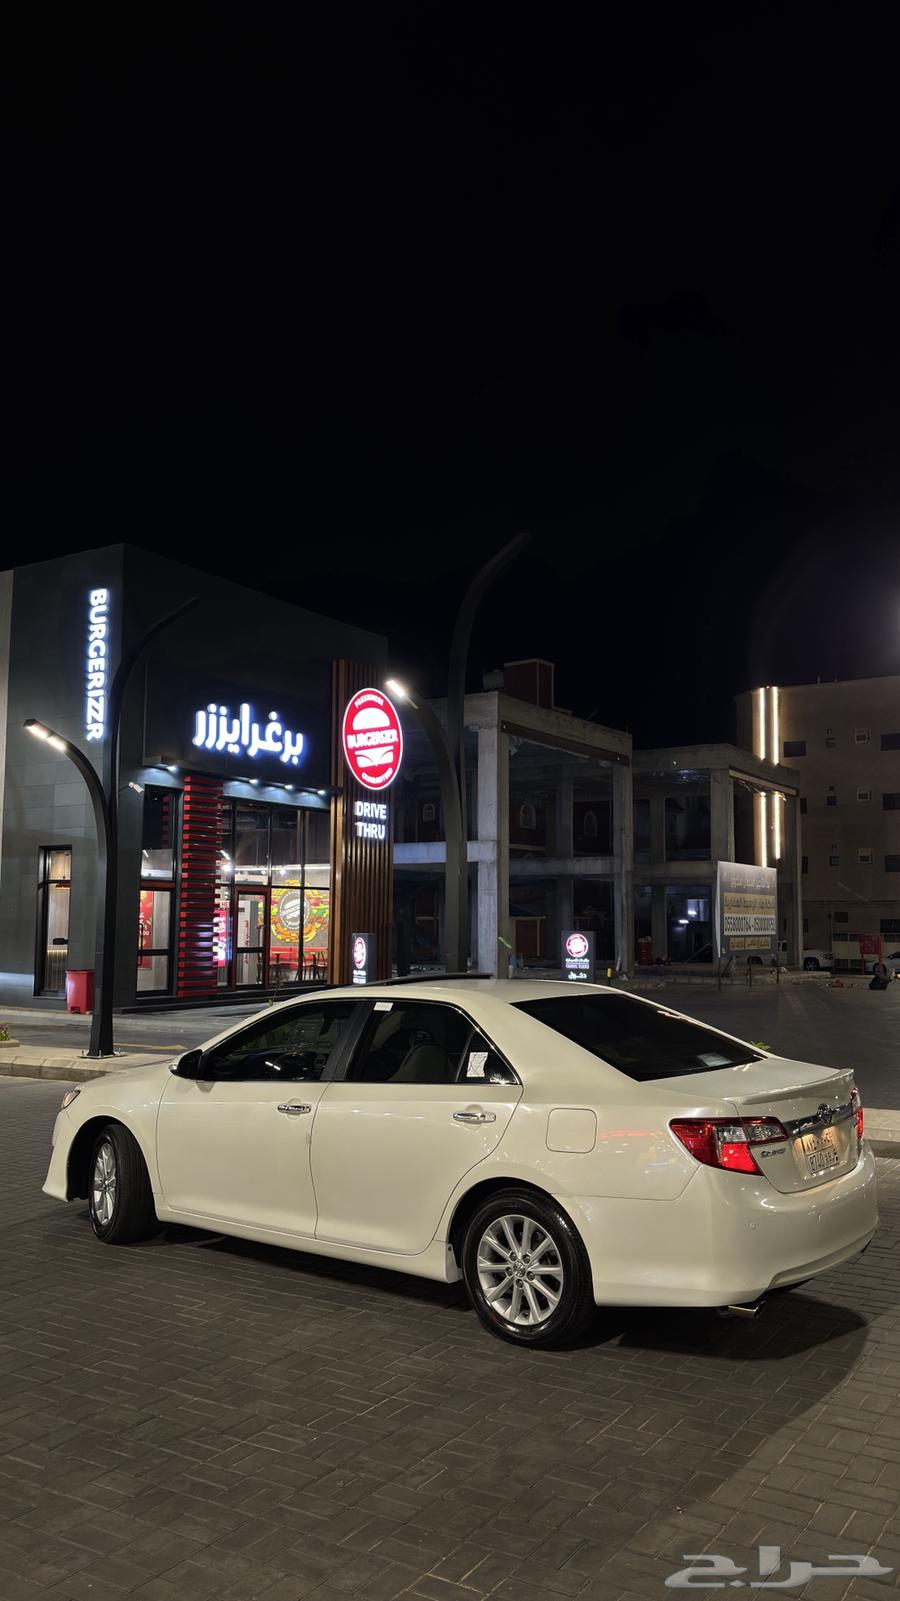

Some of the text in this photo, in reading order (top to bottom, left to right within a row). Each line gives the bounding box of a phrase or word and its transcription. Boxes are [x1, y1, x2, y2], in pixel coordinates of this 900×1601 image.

[86, 588, 107, 741] BURGERIZZR
[192, 703, 304, 765] برغرايززر
[354, 801, 387, 819] DRIVE
[354, 821, 386, 839] THRU
